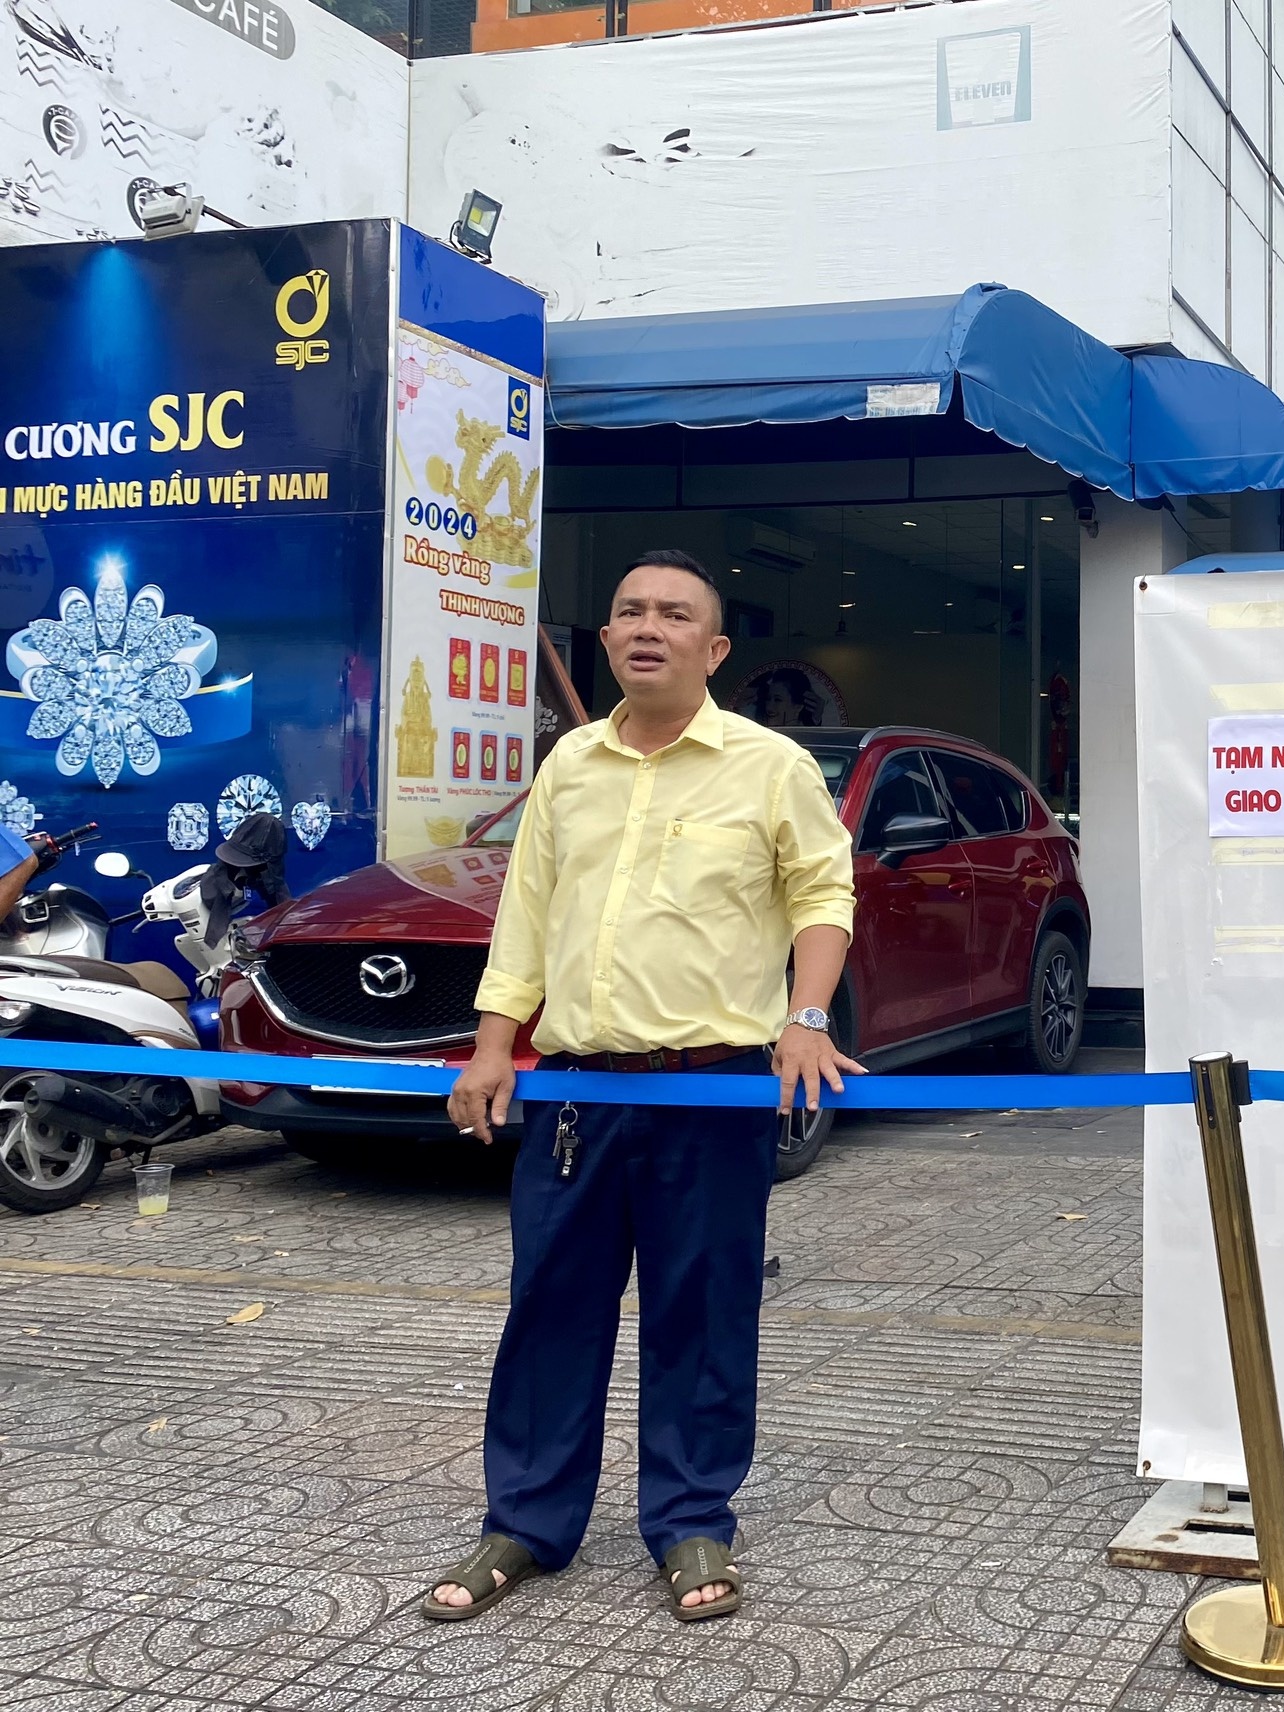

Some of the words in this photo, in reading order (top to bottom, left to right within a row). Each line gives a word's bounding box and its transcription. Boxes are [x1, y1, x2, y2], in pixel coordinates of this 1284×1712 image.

[274, 340, 330, 371] SJC
[4, 420, 137, 460] CƯƠNG
[148, 389, 245, 453] SJC
[13, 482, 69, 519] MỰC
[75, 477, 143, 512] HÀNG
[149, 469, 201, 507] ĐẦU
[207, 470, 262, 510] VIỆT
[268, 472, 330, 501] NAM
[406, 497, 477, 540] 2024
[404, 534, 450, 576] Rồng
[452, 551, 491, 585] vàng
[439, 589, 481, 617] THỊNH
[481, 598, 525, 626] VƯỢNG
[1212, 746, 1263, 774] TẠM
[1225, 789, 1282, 813] GIAO
